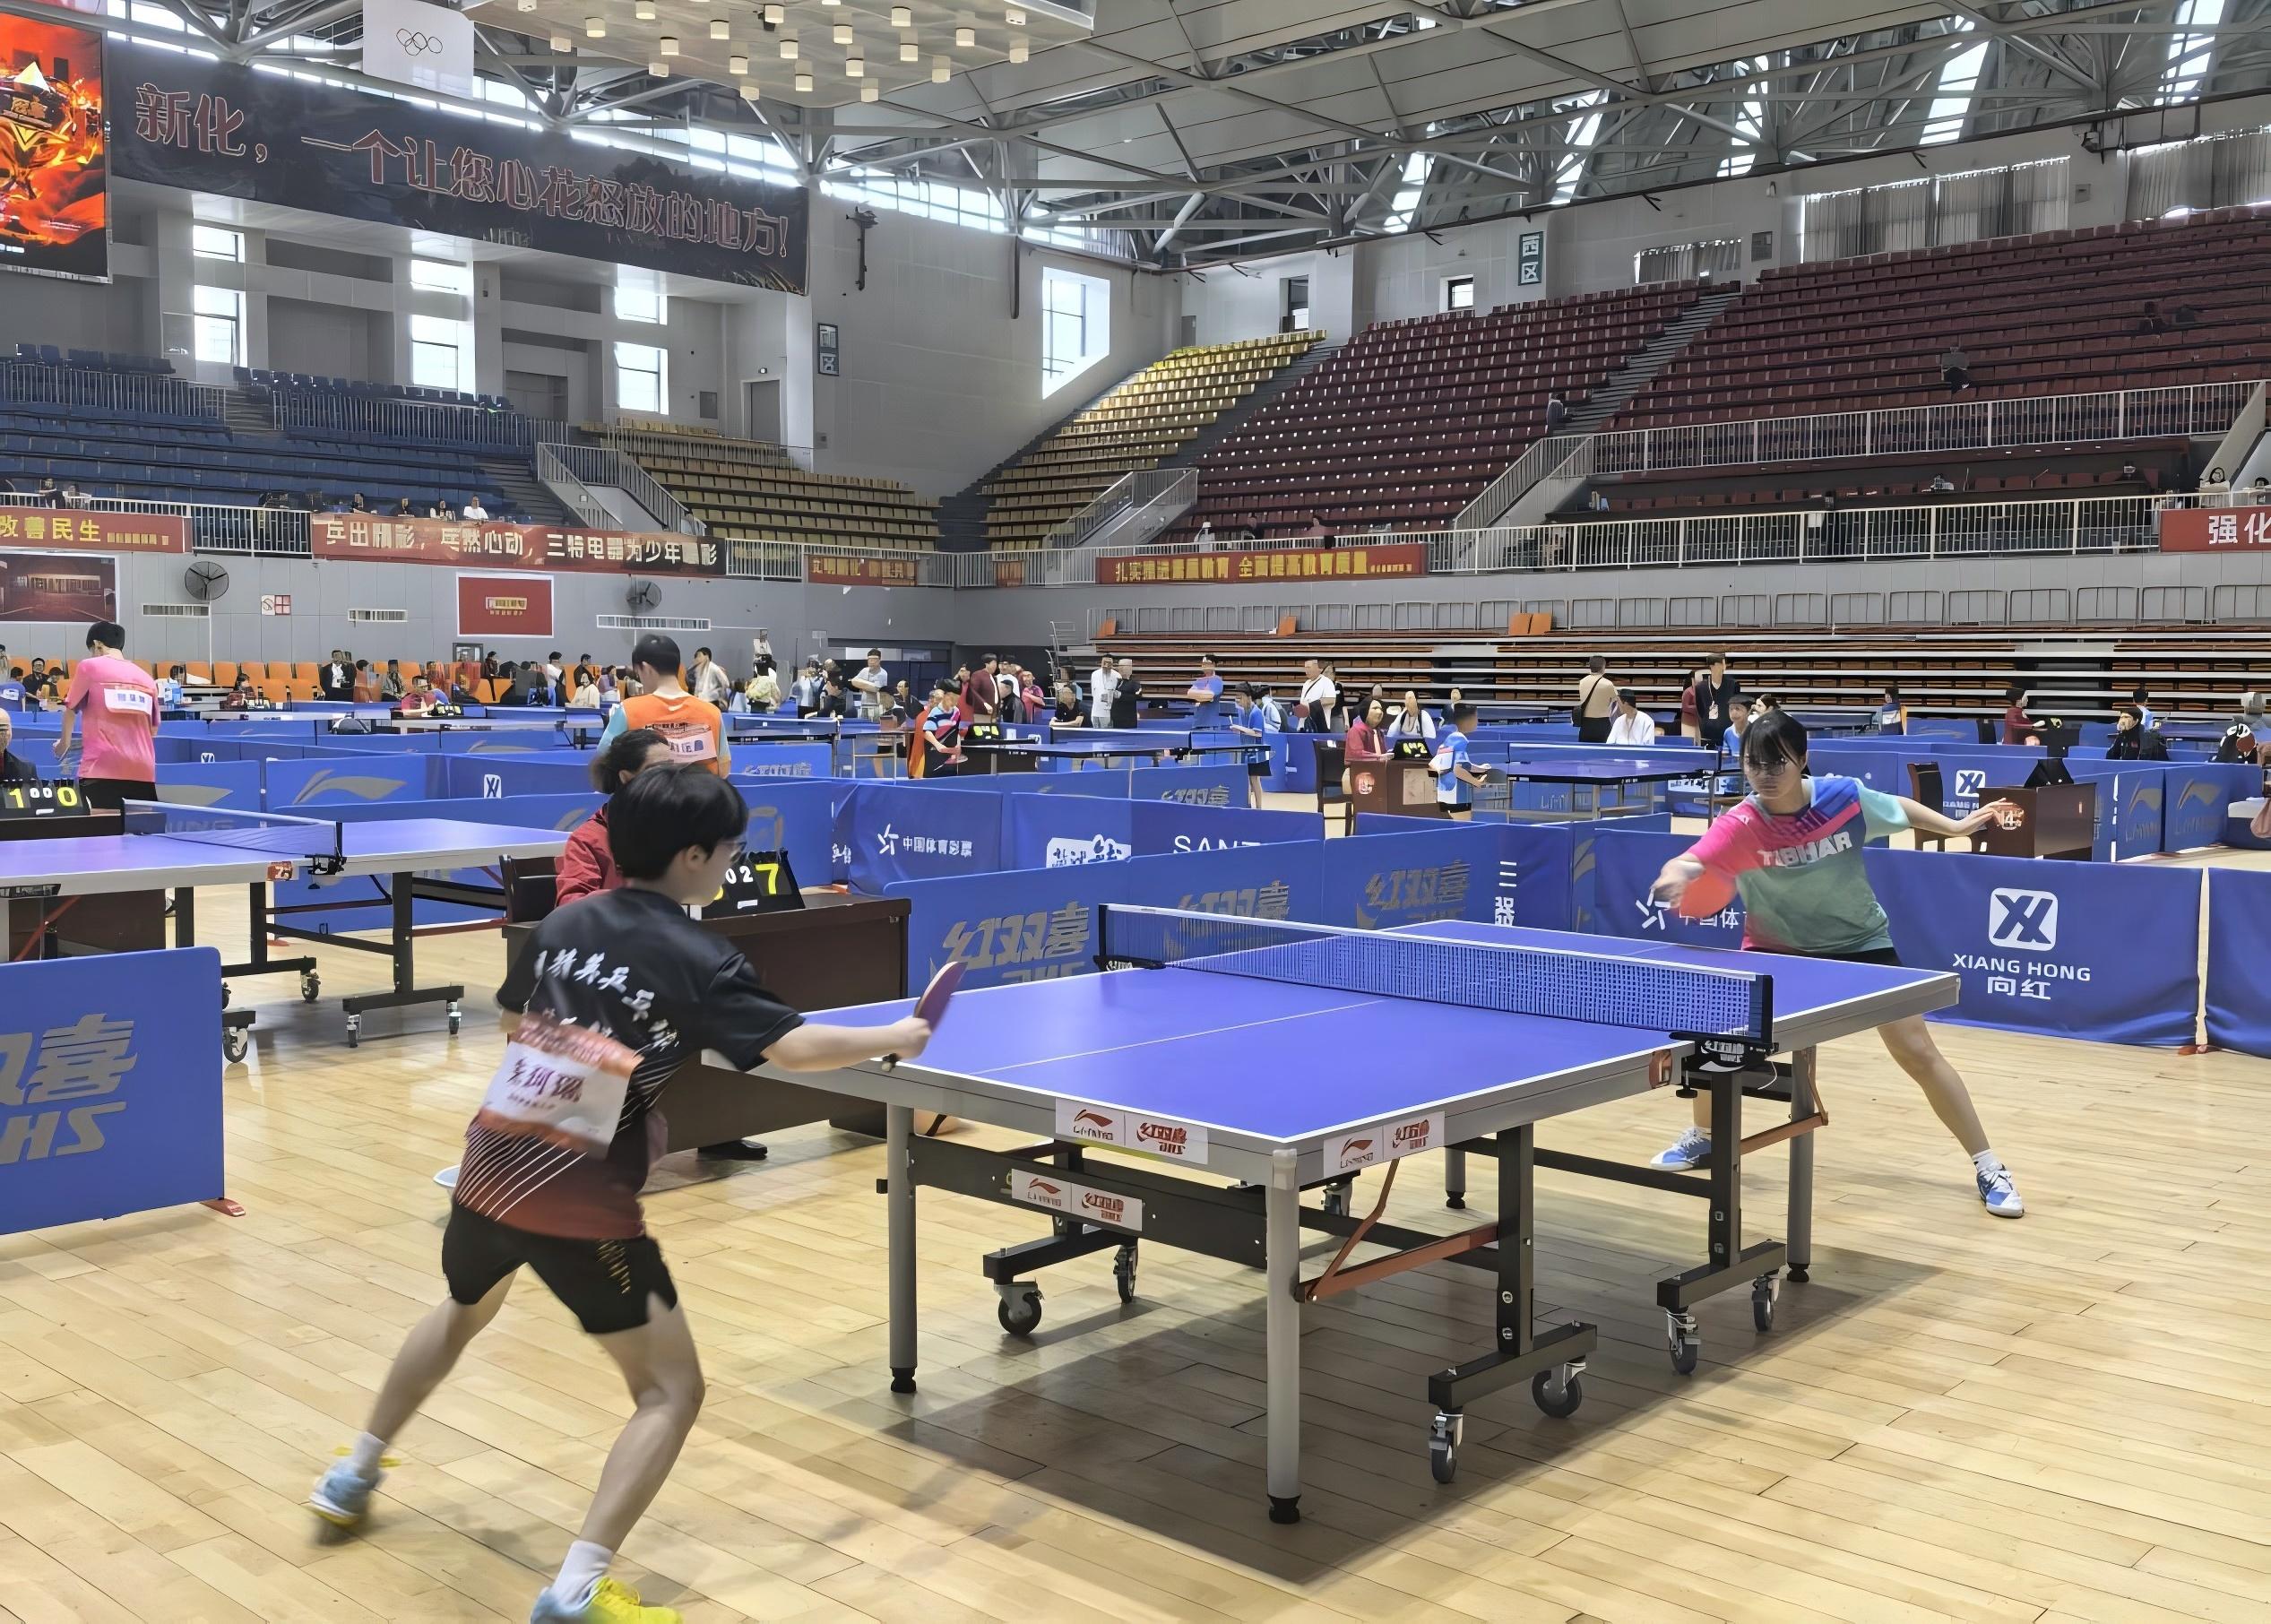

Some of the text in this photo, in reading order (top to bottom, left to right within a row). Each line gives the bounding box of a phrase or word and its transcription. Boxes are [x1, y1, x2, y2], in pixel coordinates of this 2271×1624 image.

[1522, 234, 1541, 283] 西区
[2208, 513, 2271, 544] 强化
[755, 863, 779, 894] 7
[943, 901, 1090, 970] 红双喜
[1952, 954, 2091, 981] XIANG HONG
[1987, 976, 2051, 999] 向红
